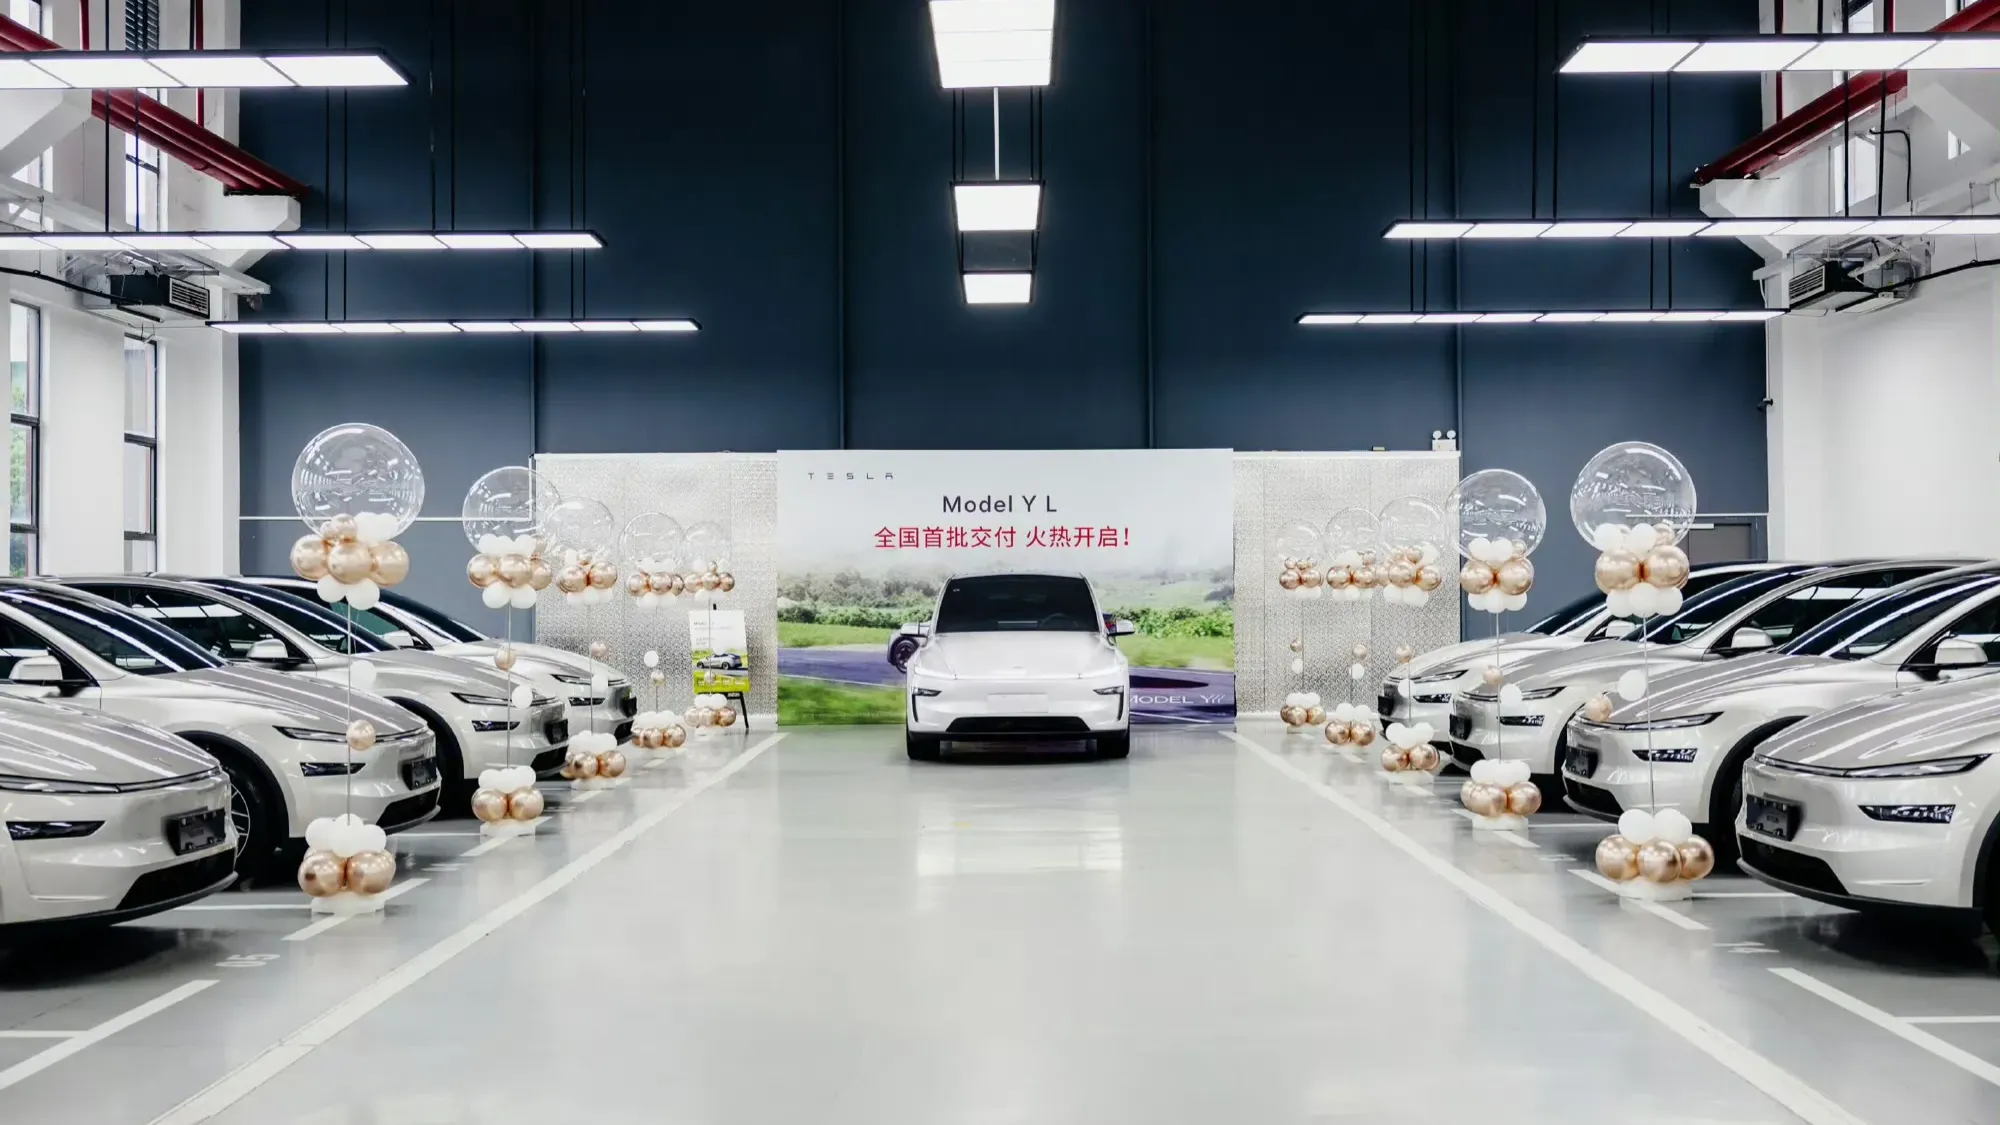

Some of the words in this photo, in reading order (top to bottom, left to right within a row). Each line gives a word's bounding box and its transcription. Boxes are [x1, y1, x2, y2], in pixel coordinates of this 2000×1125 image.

[807, 472, 894, 480] TESLA
[942, 494, 1013, 513] Model
[1021, 495, 1037, 513] Y
[1046, 495, 1058, 513] L
[874, 526, 1017, 549] 全国首批交付
